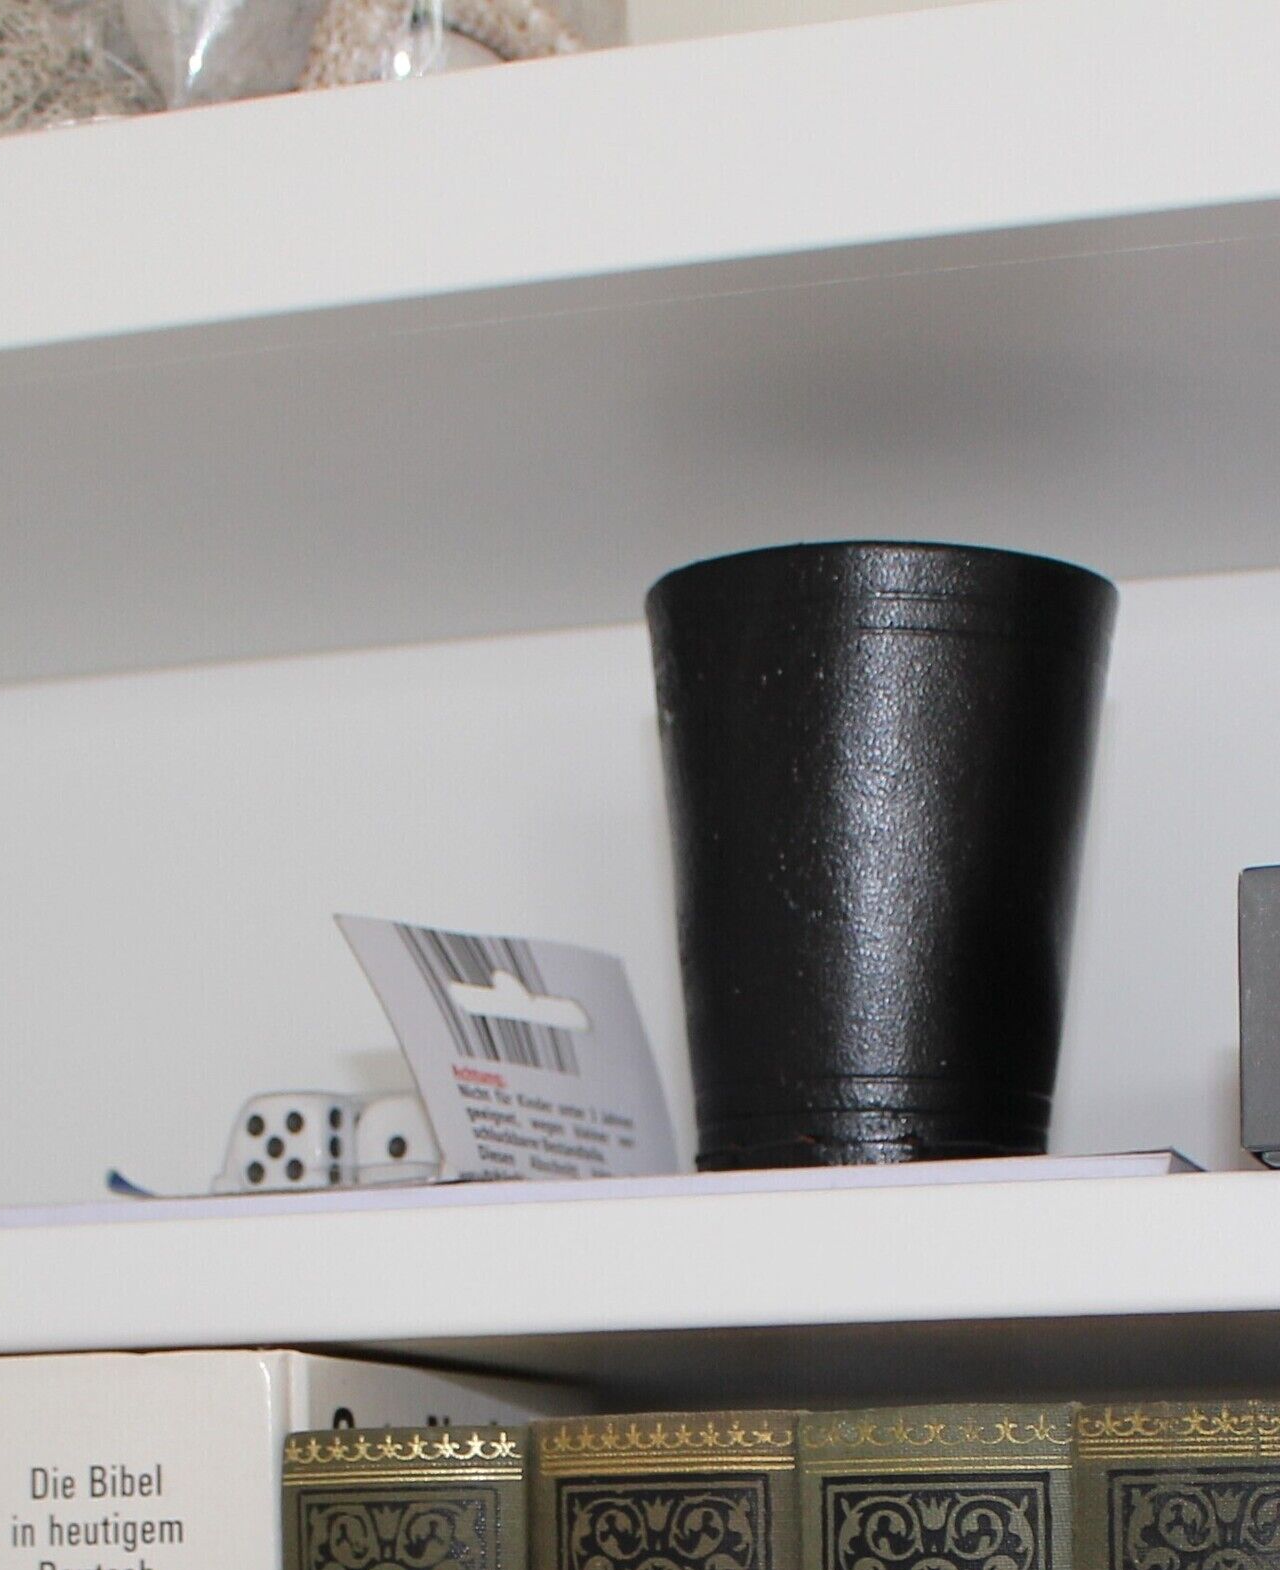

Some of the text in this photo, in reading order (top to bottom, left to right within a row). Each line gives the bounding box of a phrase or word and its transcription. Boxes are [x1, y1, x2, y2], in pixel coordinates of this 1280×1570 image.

[30, 1464, 164, 1501] Die Bibel
[11, 1512, 185, 1552] in heutigem
